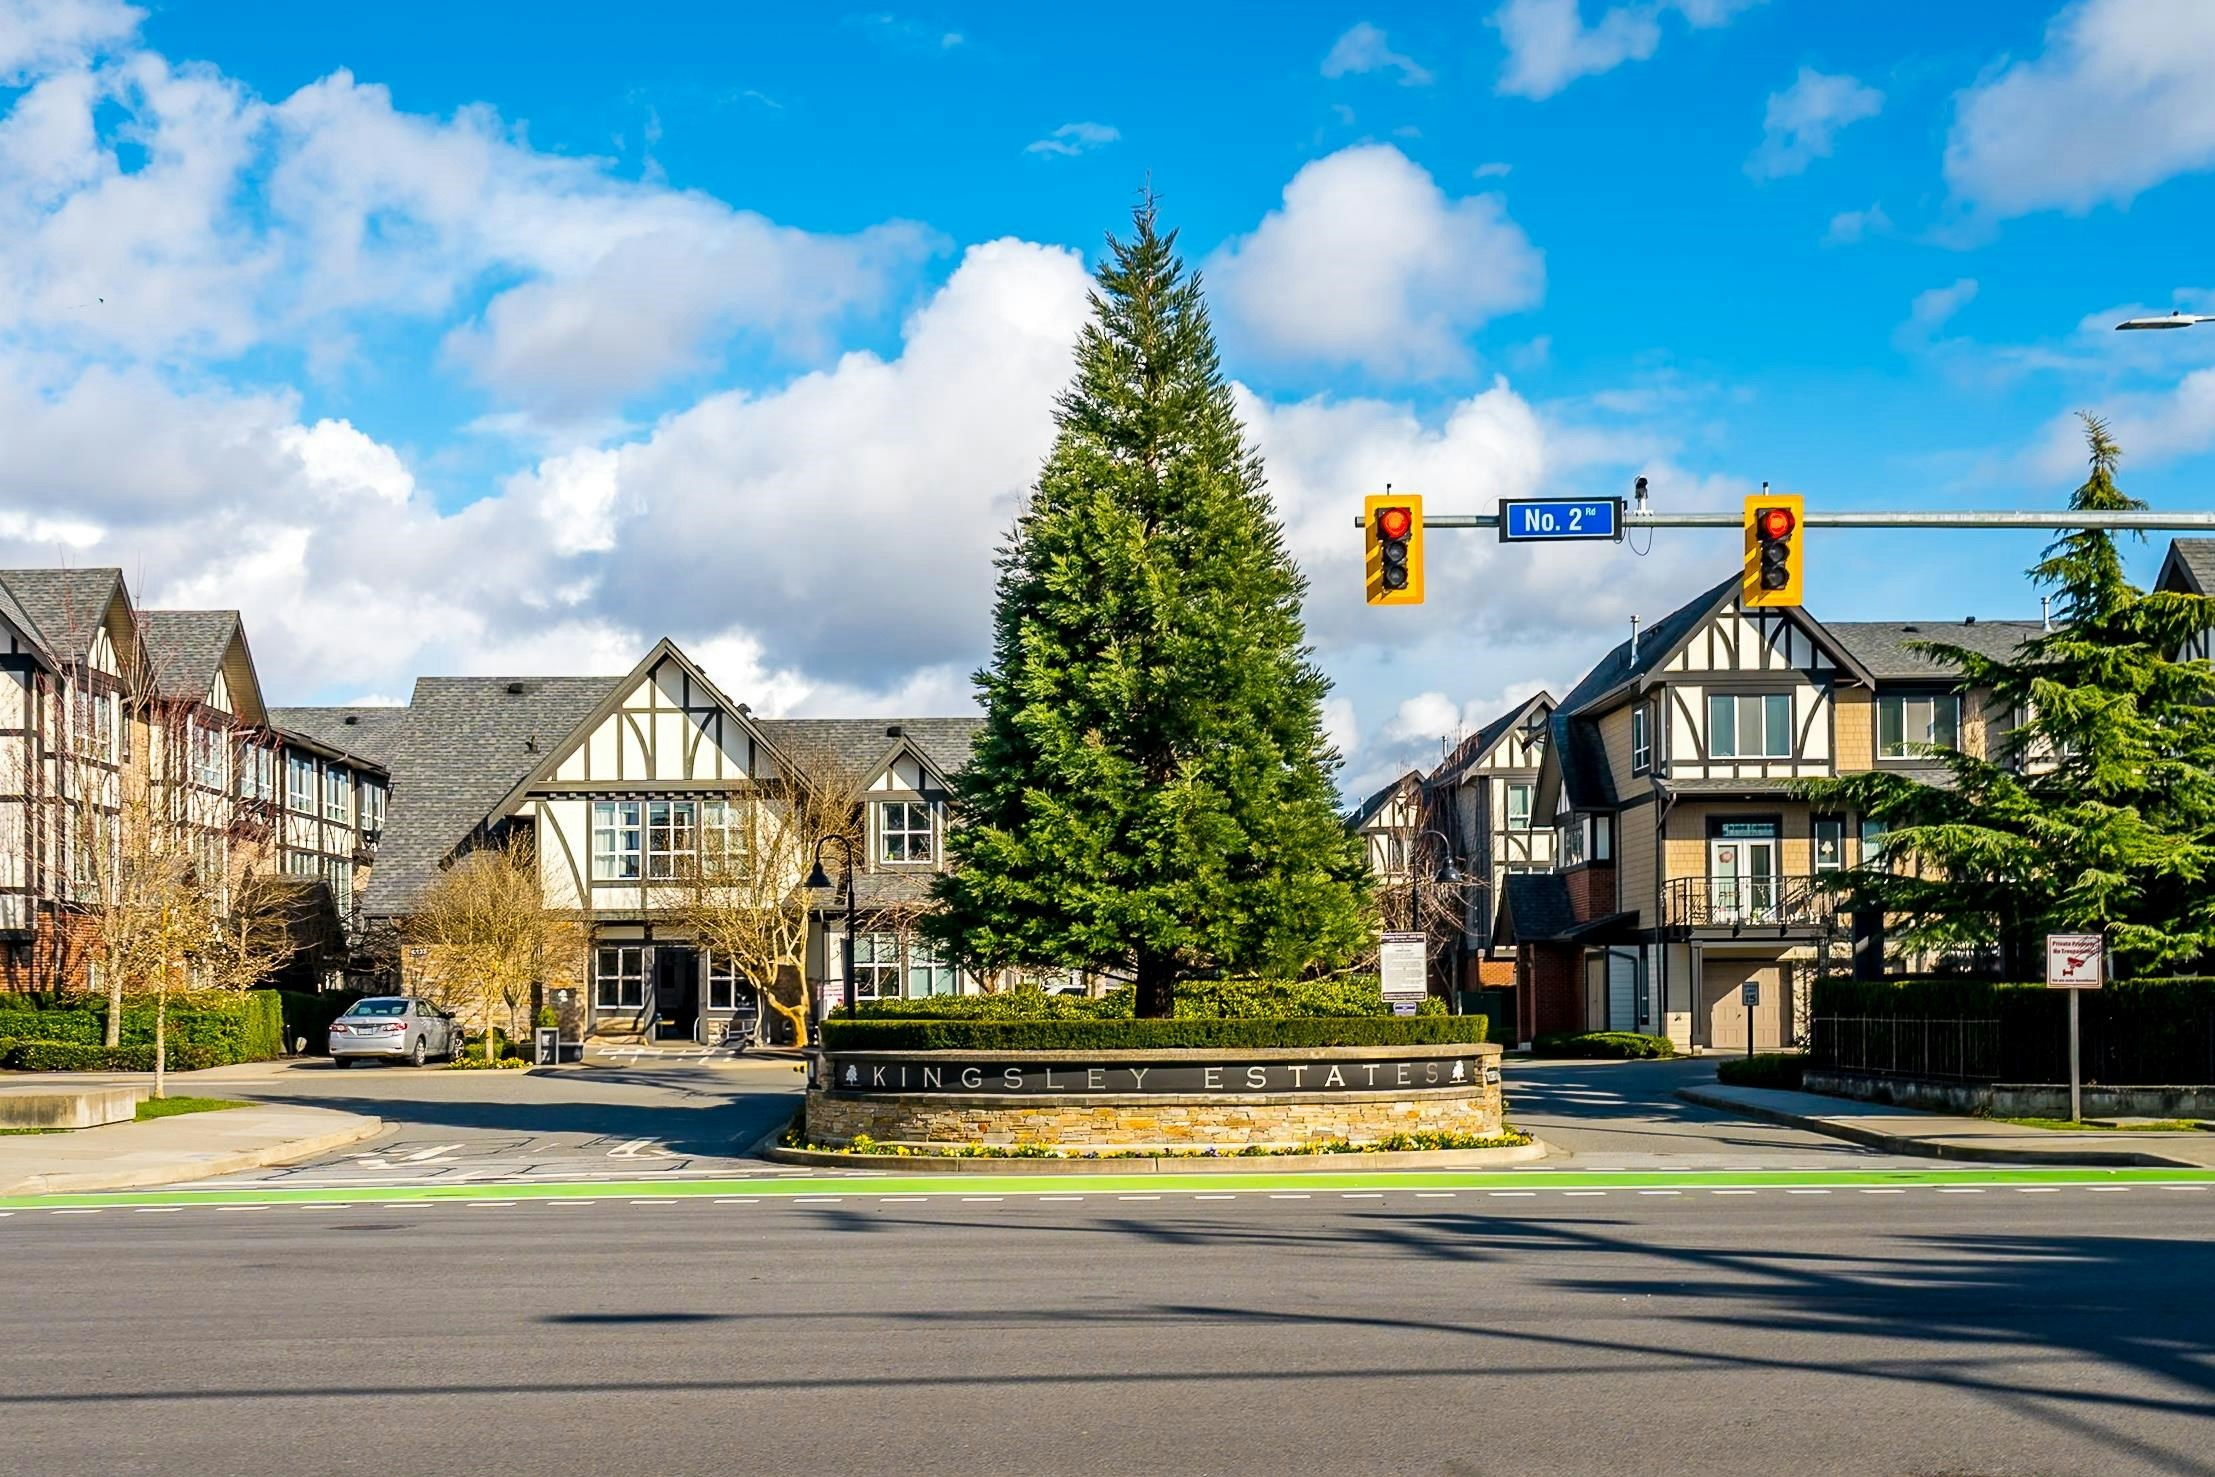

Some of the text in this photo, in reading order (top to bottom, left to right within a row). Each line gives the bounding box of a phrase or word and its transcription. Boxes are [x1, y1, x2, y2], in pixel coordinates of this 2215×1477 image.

[1525, 507, 1596, 532] No. 2 Rd
[873, 1062, 1439, 1090] KINGSLEY ESTATES
